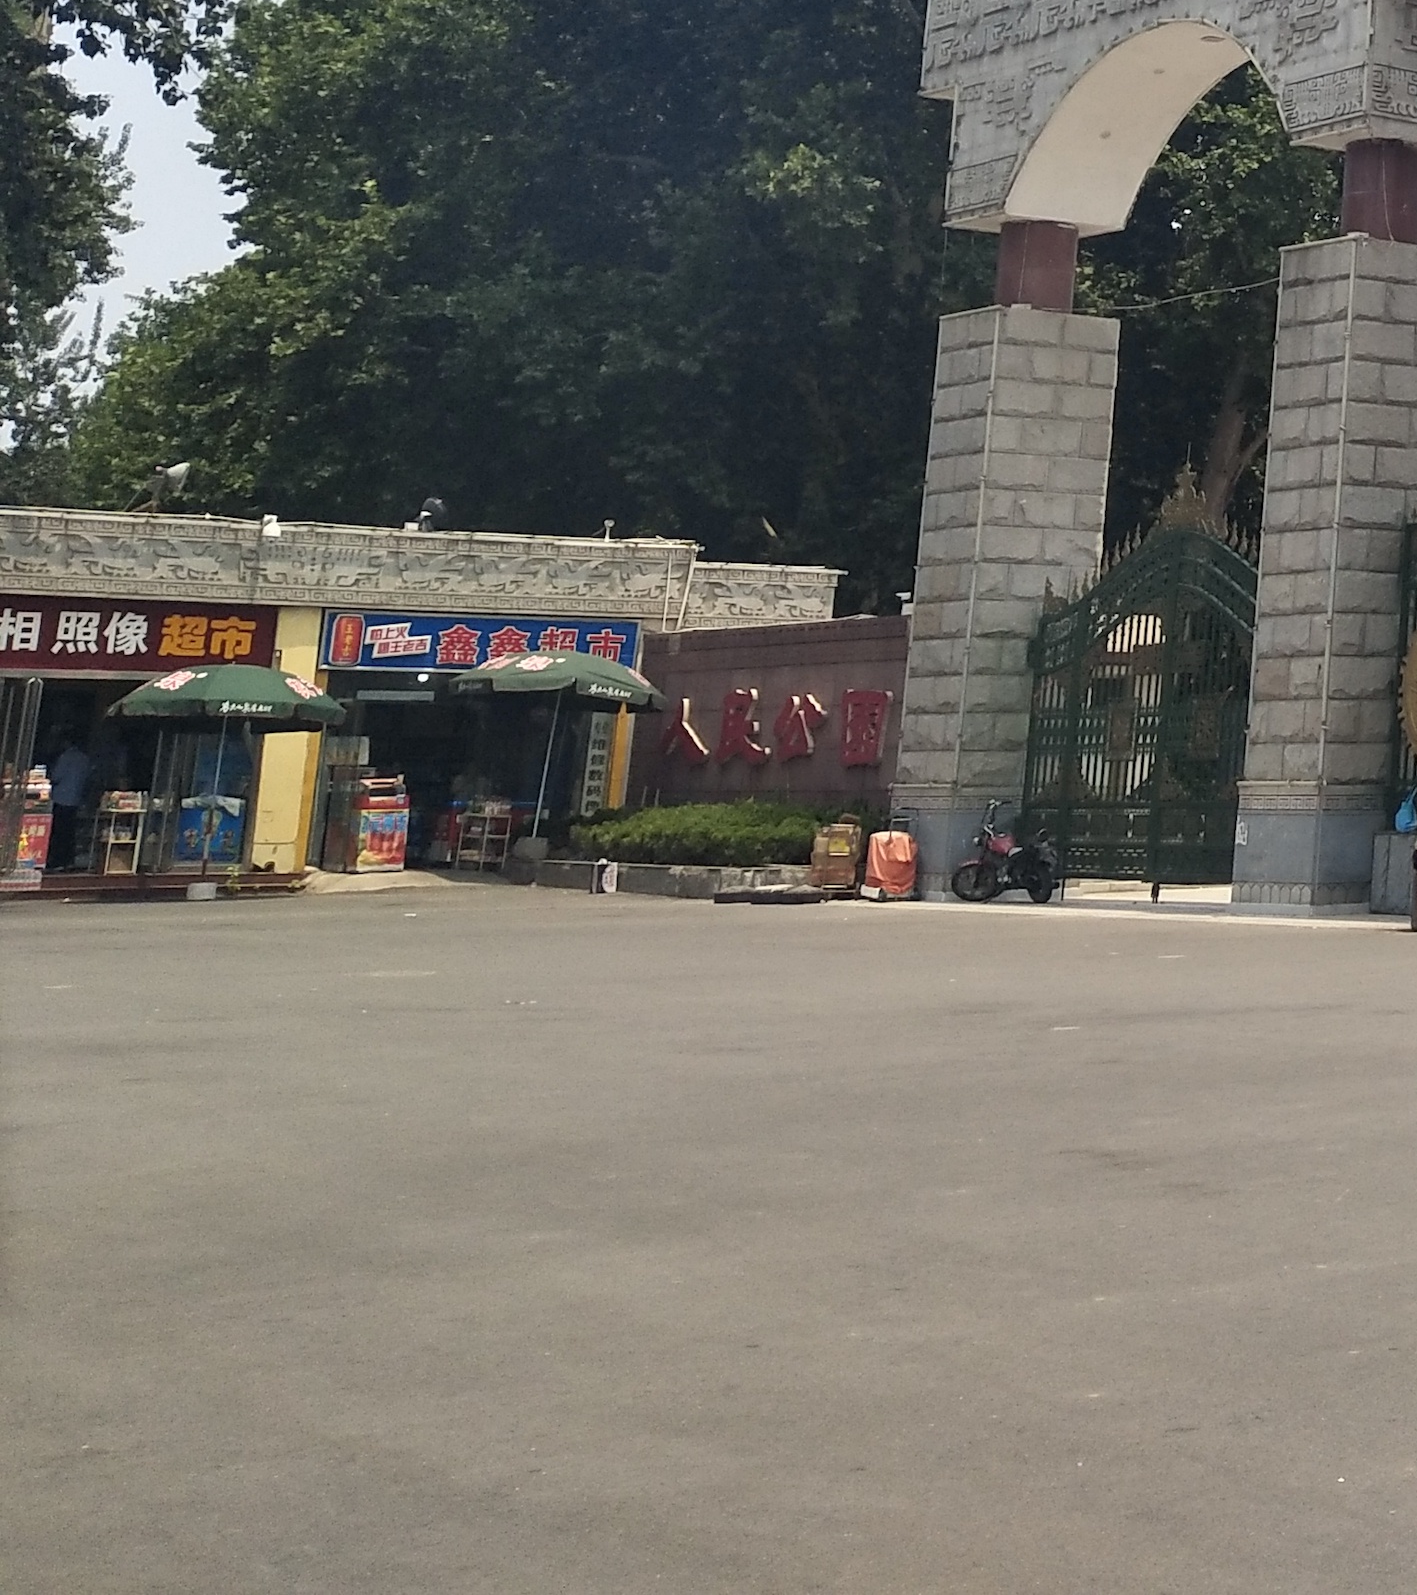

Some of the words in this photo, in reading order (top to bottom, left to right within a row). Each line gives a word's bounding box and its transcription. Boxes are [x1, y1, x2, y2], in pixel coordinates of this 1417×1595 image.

[158, 614, 256, 659] 超市
[436, 624, 626, 665] 鑫鑫超市
